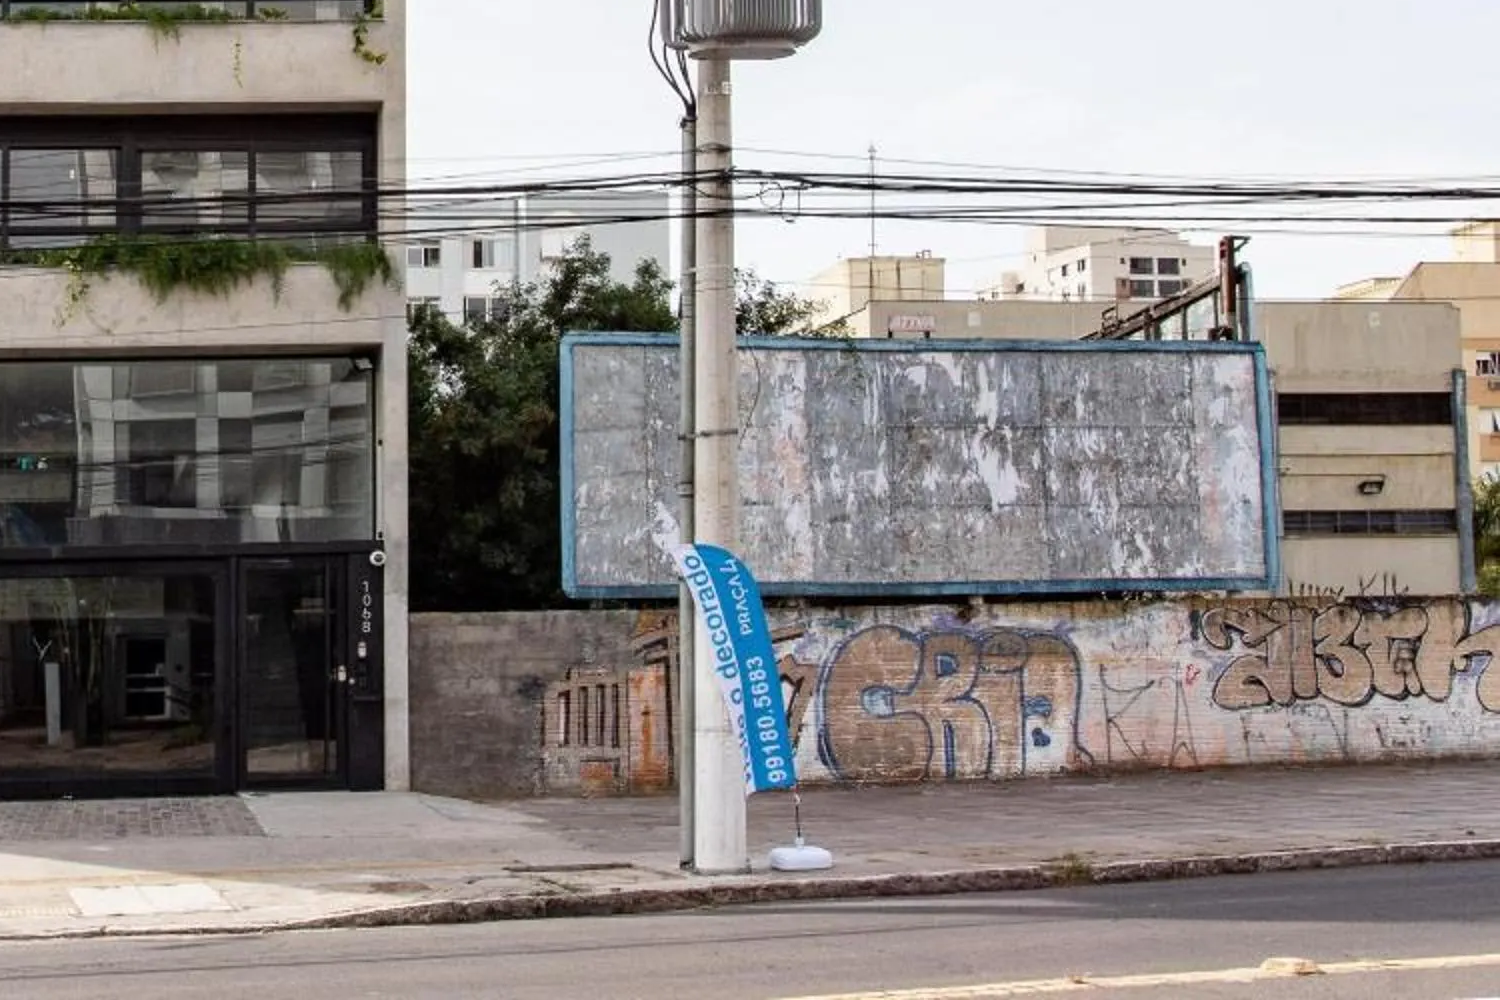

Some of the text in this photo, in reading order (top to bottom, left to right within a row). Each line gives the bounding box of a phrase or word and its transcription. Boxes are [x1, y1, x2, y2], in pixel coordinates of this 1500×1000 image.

[361, 580, 371, 633] 1068
[719, 558, 738, 574] 4
[684, 555, 739, 679] decorado
[746, 656, 787, 783] 99180.5683
